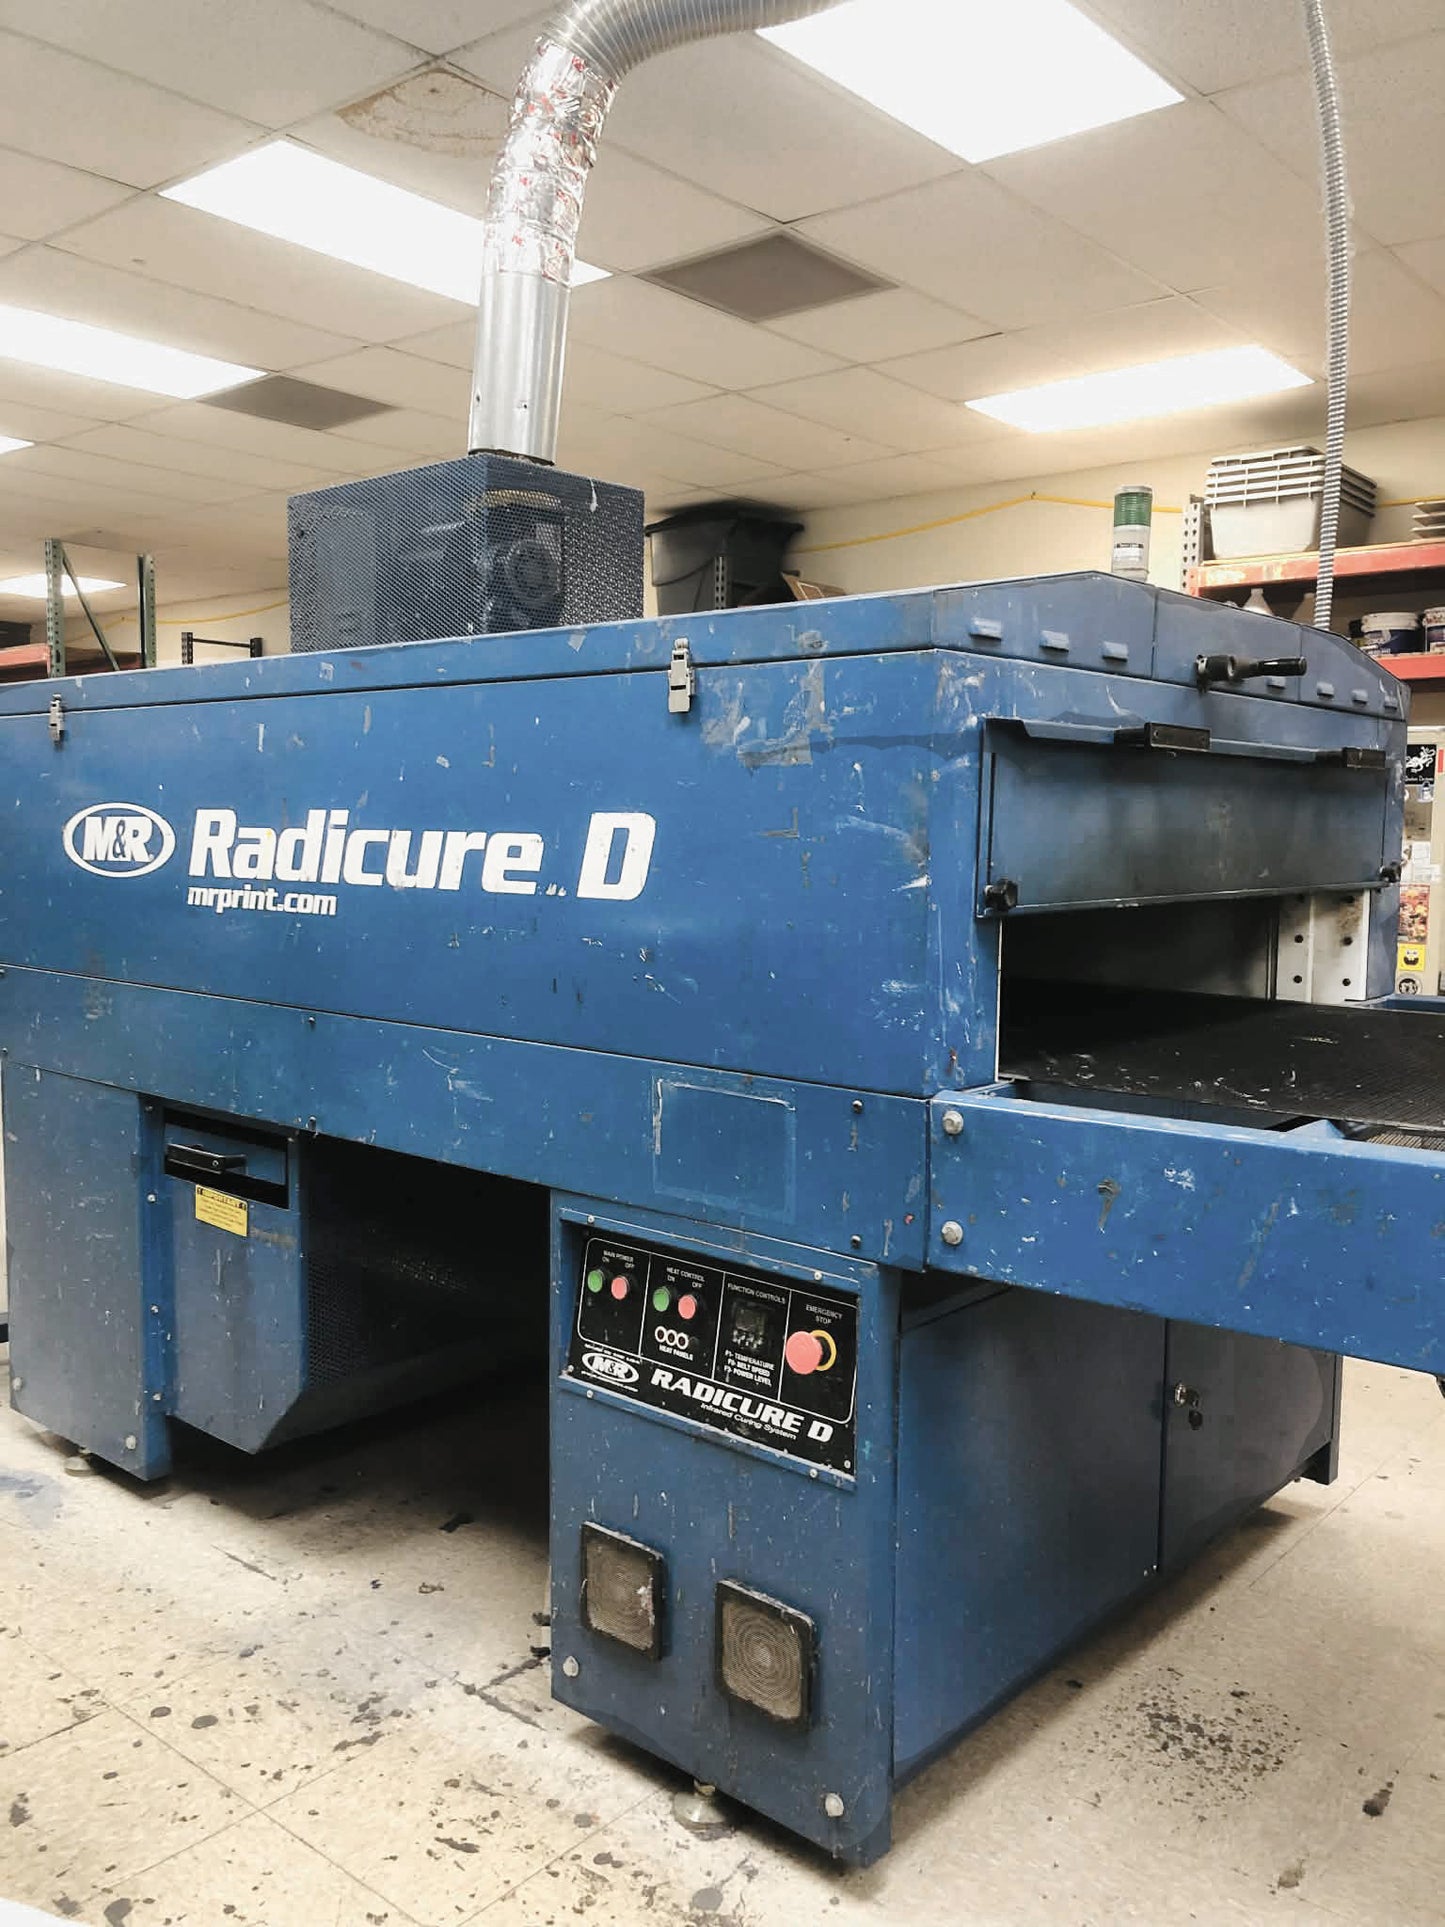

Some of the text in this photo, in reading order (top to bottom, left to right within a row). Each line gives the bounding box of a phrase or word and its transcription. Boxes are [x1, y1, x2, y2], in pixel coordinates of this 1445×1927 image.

[187, 808, 658, 901] Radicure D
[187, 886, 338, 916] mrprint.com
[666, 1267, 705, 1282] HEAT CONTROL
[727, 1282, 786, 1304] FUNCTION CONTROLS
[805, 1304, 843, 1319] EMERGENCY
[815, 1315, 832, 1325] STOP
[734, 1352, 775, 1371] TEMPERATURE
[751, 1365, 771, 1377] SPEED
[733, 1367, 754, 1380] POWER
[754, 1374, 772, 1387] LEVEL
[650, 1368, 805, 1433] RADICURE
[807, 1420, 833, 1443] D
[700, 1402, 797, 1441] Infrared Curing System
